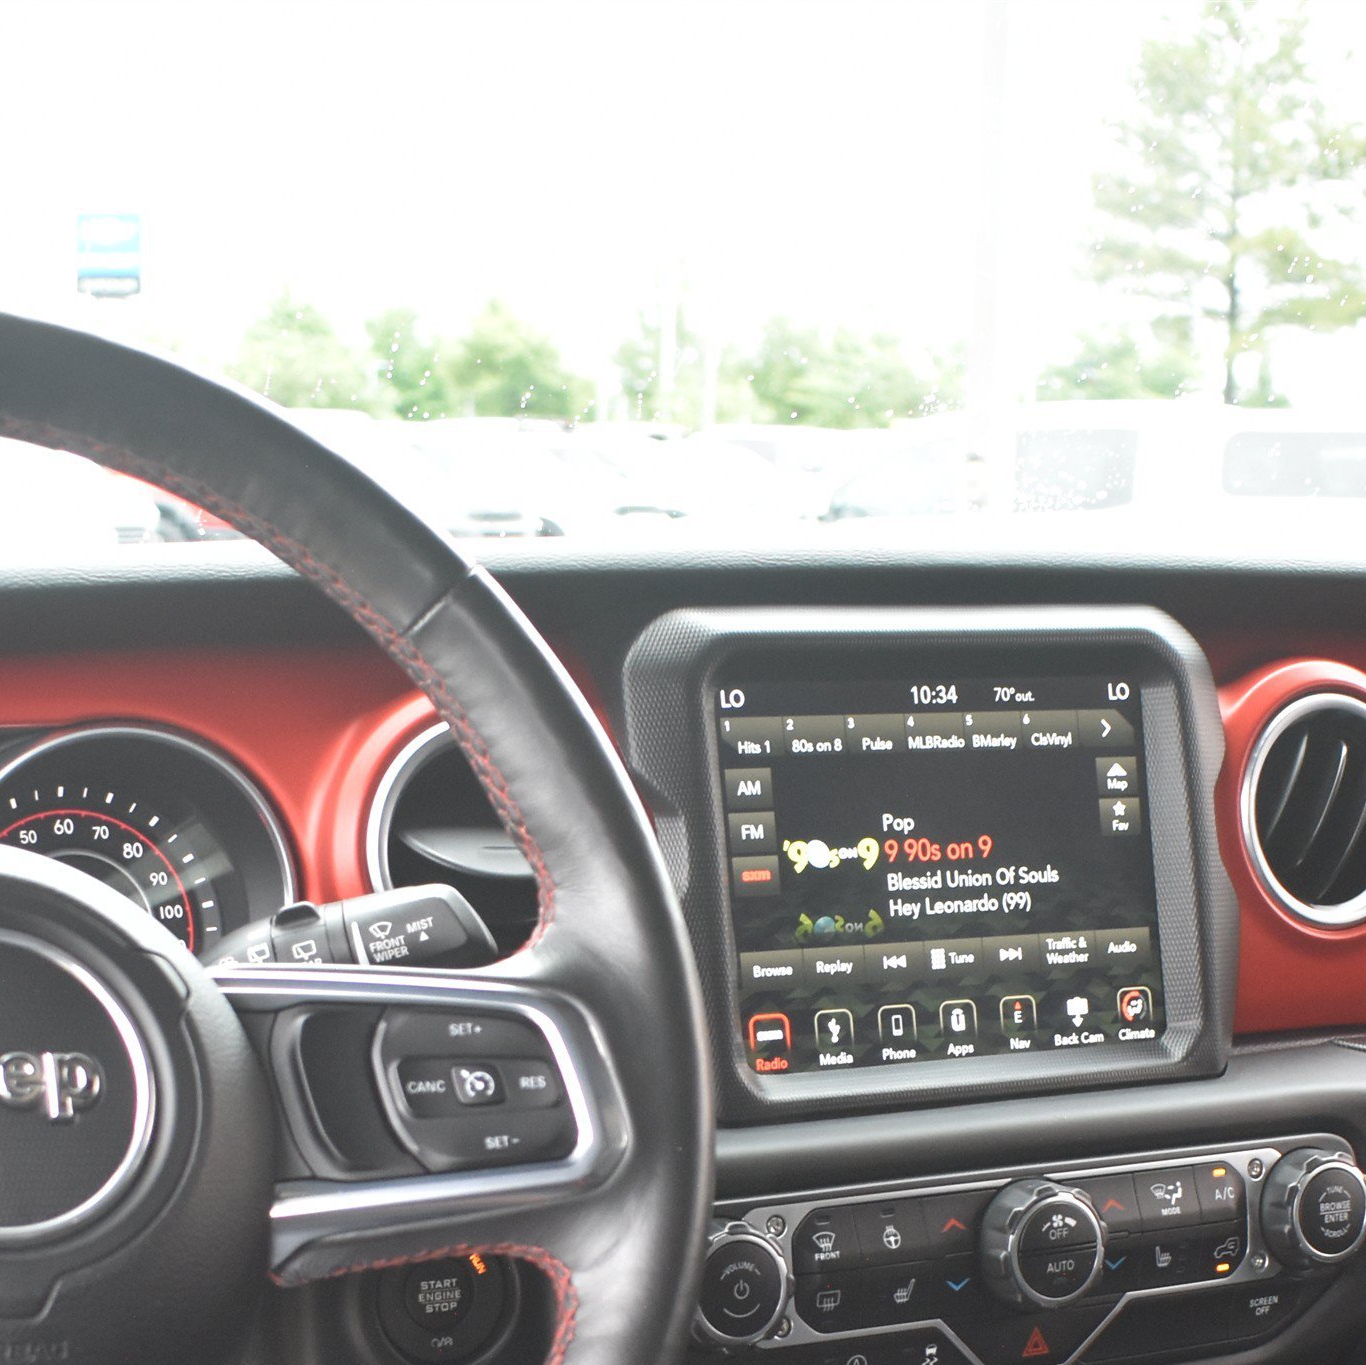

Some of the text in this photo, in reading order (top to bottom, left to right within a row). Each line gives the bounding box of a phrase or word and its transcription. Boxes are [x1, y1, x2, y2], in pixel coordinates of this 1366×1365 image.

[720, 689, 745, 708] LO
[910, 685, 958, 704] 10:34
[1108, 682, 1130, 700] LO
[786, 718, 794, 731] 2
[847, 717, 855, 729] 3
[907, 715, 914, 727] 4
[965, 714, 973, 726] 5
[1022, 713, 1030, 725] 6
[724, 721, 730, 732] 1
[737, 739, 771, 755] Hits 1
[791, 738, 842, 752] 80s on 8
[862, 736, 893, 750] Pulse
[908, 734, 965, 749] MLBRadio
[972, 734, 1017, 750] BMarley
[737, 780, 761, 796] AM
[1107, 779, 1128, 791] Map
[53, 818, 74, 834] 60
[882, 814, 915, 834] Pop
[1112, 821, 1129, 831] Fav
[19, 830, 37, 844] 50
[92, 826, 109, 839] 70
[741, 823, 764, 840] FM
[123, 842, 143, 858] 80
[885, 834, 993, 862] 9 90s on 9
[149, 872, 167, 886] 90
[887, 864, 1060, 891] Blessid Union Of Souls
[159, 904, 183, 919] 100
[889, 892, 1032, 919] Hey Leonardo (99)
[406, 917, 434, 934] MIST
[369, 935, 405, 953] FRONT
[1046, 937, 1087, 950] Traffic &
[1107, 941, 1137, 954] Audio
[373, 945, 409, 963] WIPER
[949, 953, 974, 964] Tune
[1046, 952, 1089, 965] Weather
[753, 965, 793, 978] Browse
[816, 960, 853, 975] Replay
[1054, 1032, 1105, 1046] Back Cam
[1118, 1028, 1155, 1041] Climate
[947, 1043, 974, 1057] Apps
[1010, 1038, 1030, 1050] Nav
[819, 1053, 854, 1066] Media
[882, 1048, 916, 1061] Phone
[756, 1057, 789, 1071] Radio
[407, 1080, 446, 1093] CANC
[520, 1076, 546, 1089] RES
[1215, 1187, 1235, 1201] A/C
[1161, 1206, 1181, 1216] MODE
[1320, 1200, 1351, 1212] BROWSE
[1325, 1212, 1348, 1223] ENTER
[1049, 1227, 1069, 1240] OFF
[814, 1251, 840, 1261] FRONT
[724, 1262, 755, 1275] VOLUME
[1047, 1260, 1075, 1273] AUTO
[420, 1278, 457, 1290] START
[418, 1289, 461, 1302] ENGINE
[1249, 1296, 1278, 1308] SCREEN
[425, 1302, 457, 1313] STOP
[1255, 1305, 1270, 1316] OFF
